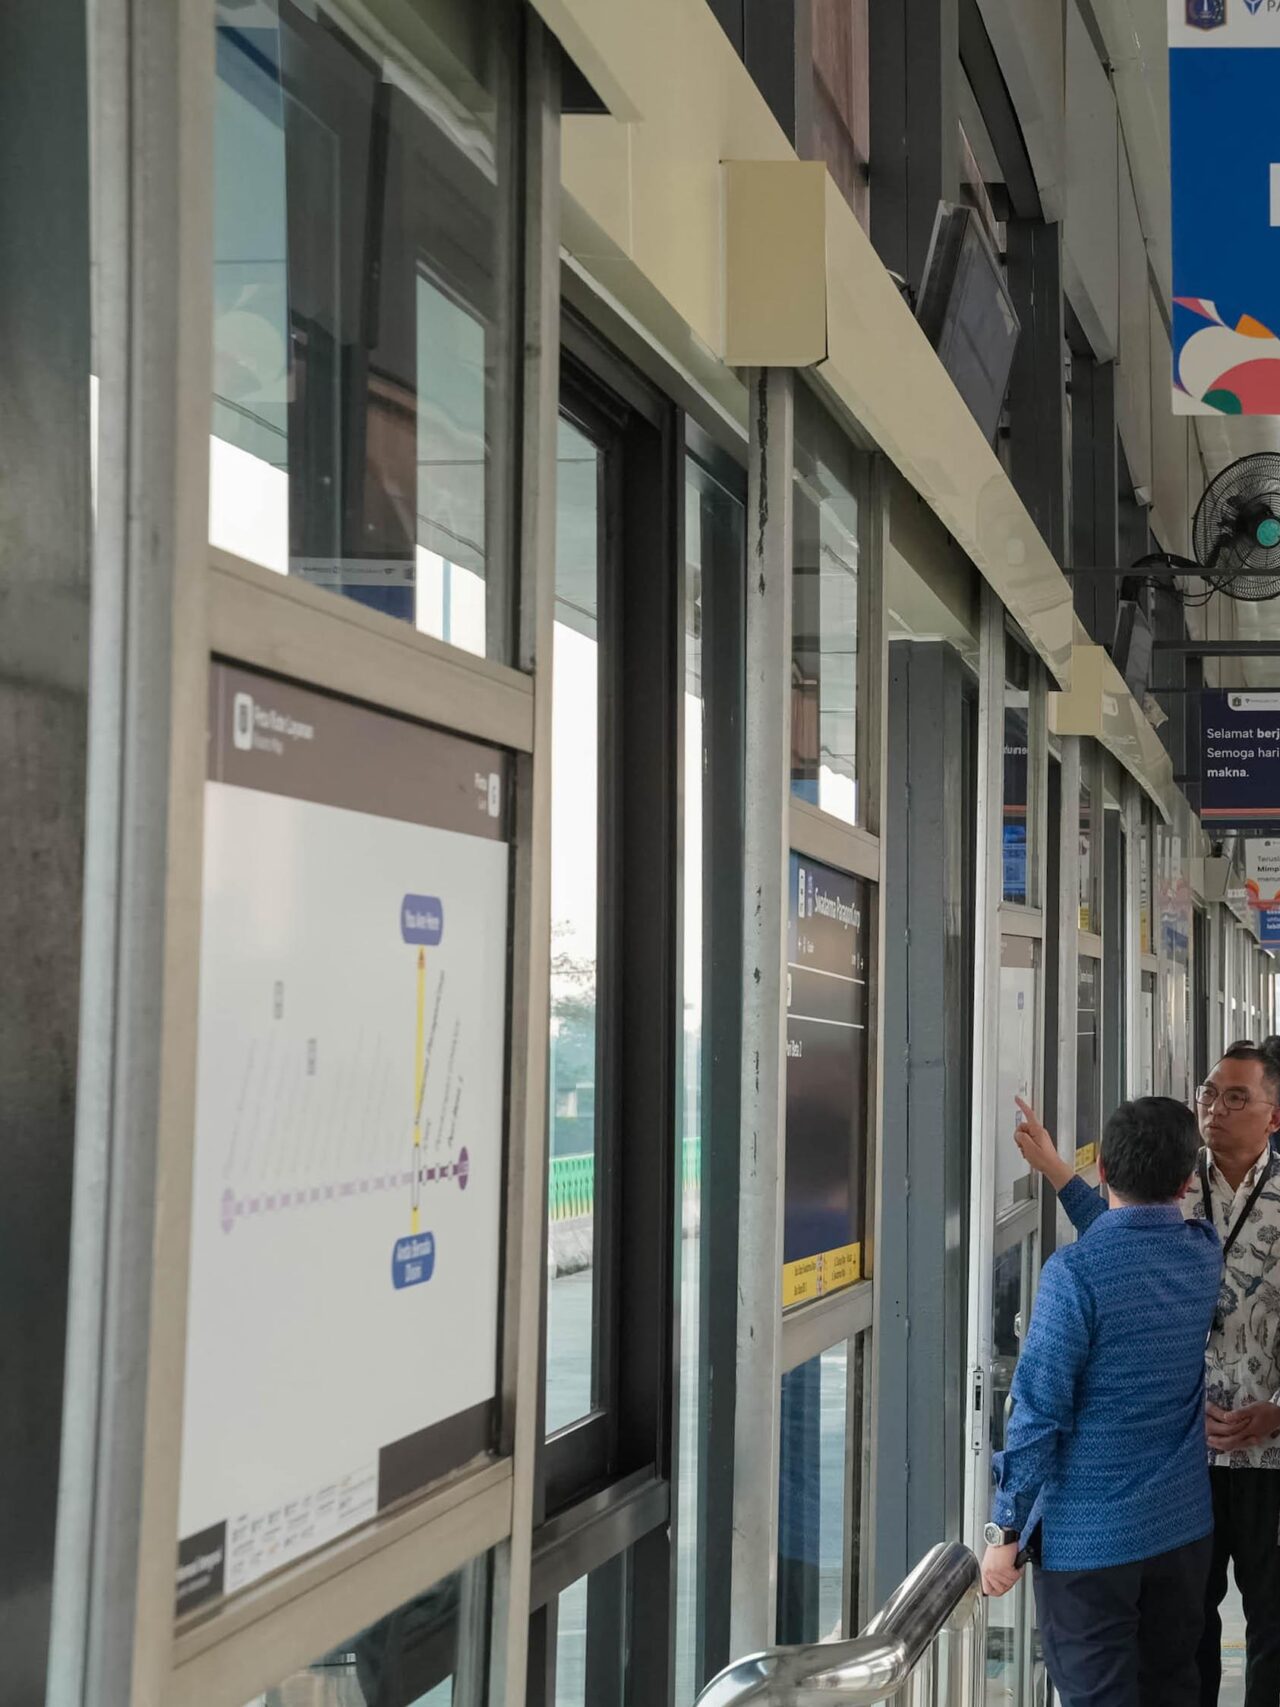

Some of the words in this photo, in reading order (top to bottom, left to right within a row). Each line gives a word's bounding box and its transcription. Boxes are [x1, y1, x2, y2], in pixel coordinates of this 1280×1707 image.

[1207, 728, 1253, 739] Selamat
[1207, 748, 1254, 760] Semoga
[1258, 747, 1280, 758] hari
[1207, 767, 1249, 778] makna.
